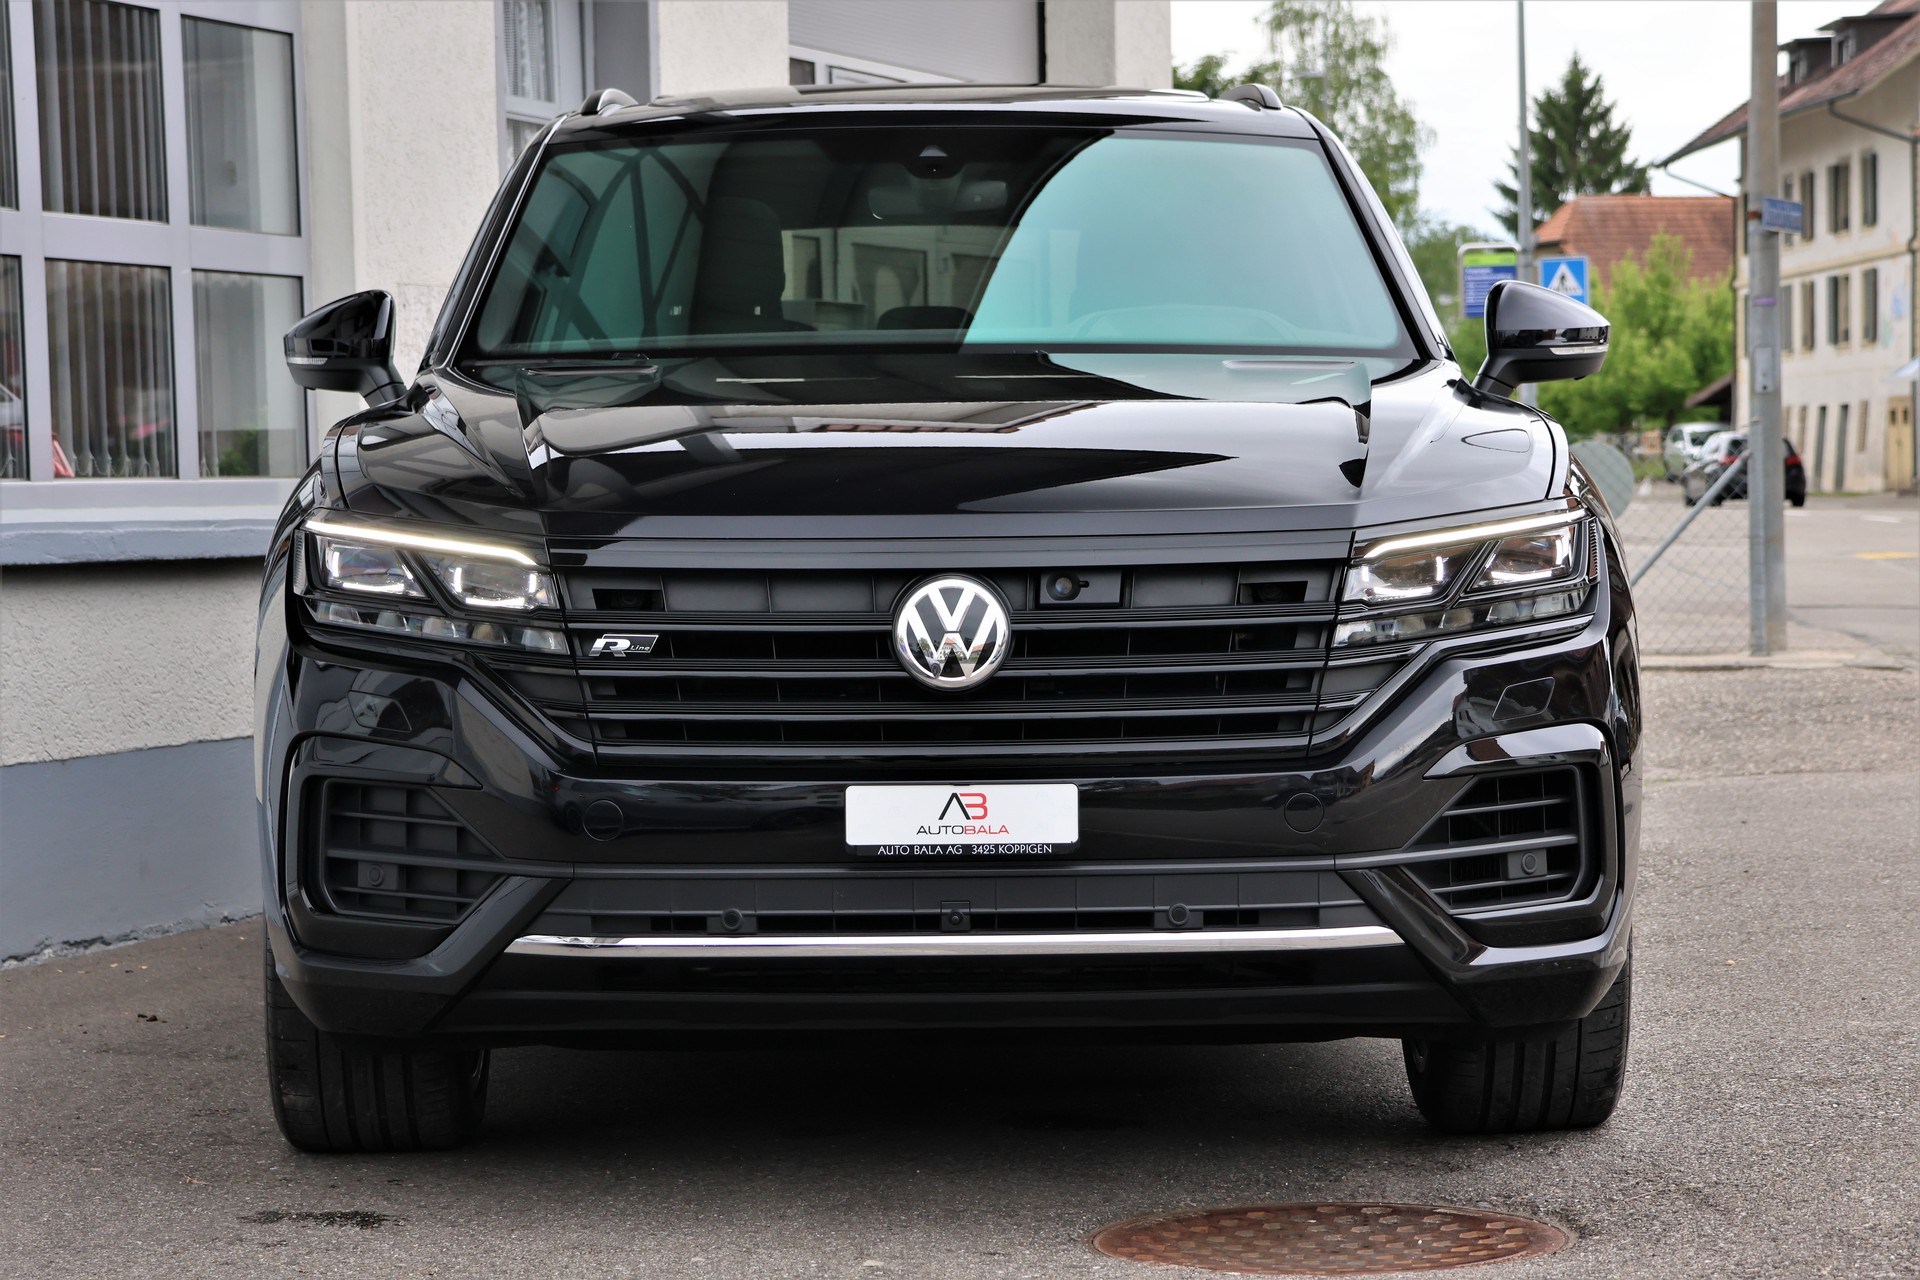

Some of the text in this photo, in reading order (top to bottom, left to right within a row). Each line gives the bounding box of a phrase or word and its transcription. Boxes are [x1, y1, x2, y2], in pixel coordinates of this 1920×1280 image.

[588, 638, 630, 657] R
[938, 792, 988, 820] AB
[916, 824, 1009, 835] AUTOBALA
[877, 844, 1052, 855] AUTO BALA AG 3425 KOPPIGEN
